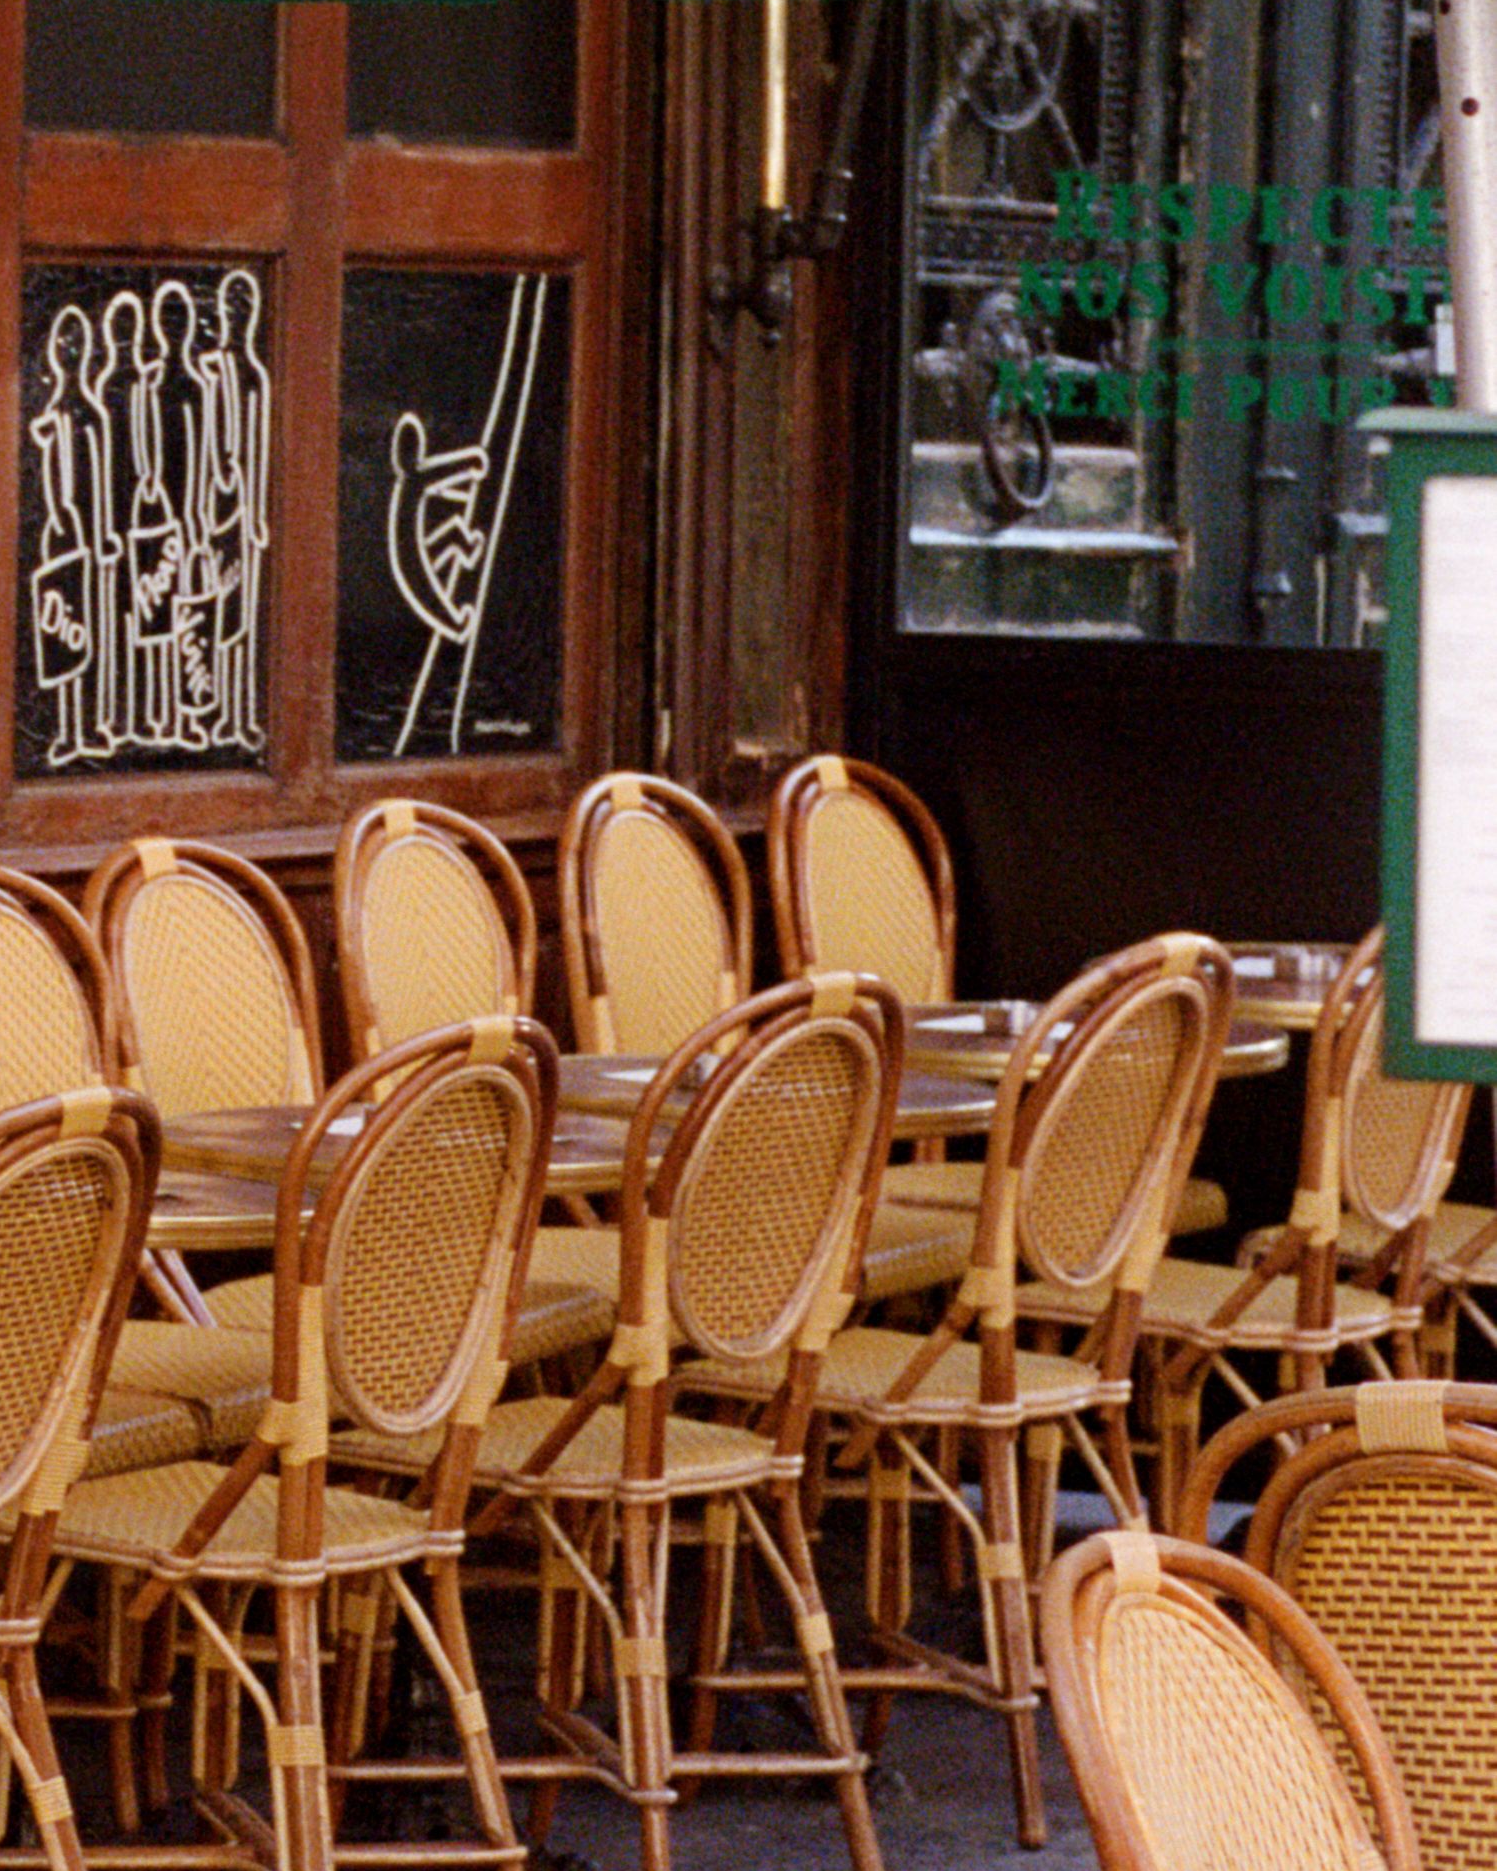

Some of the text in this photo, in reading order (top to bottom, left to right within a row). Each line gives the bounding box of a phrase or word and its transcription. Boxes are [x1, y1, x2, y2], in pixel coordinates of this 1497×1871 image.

[1015, 260, 1453, 326] NOS VOISI
[994, 357, 1195, 418] MERCI
